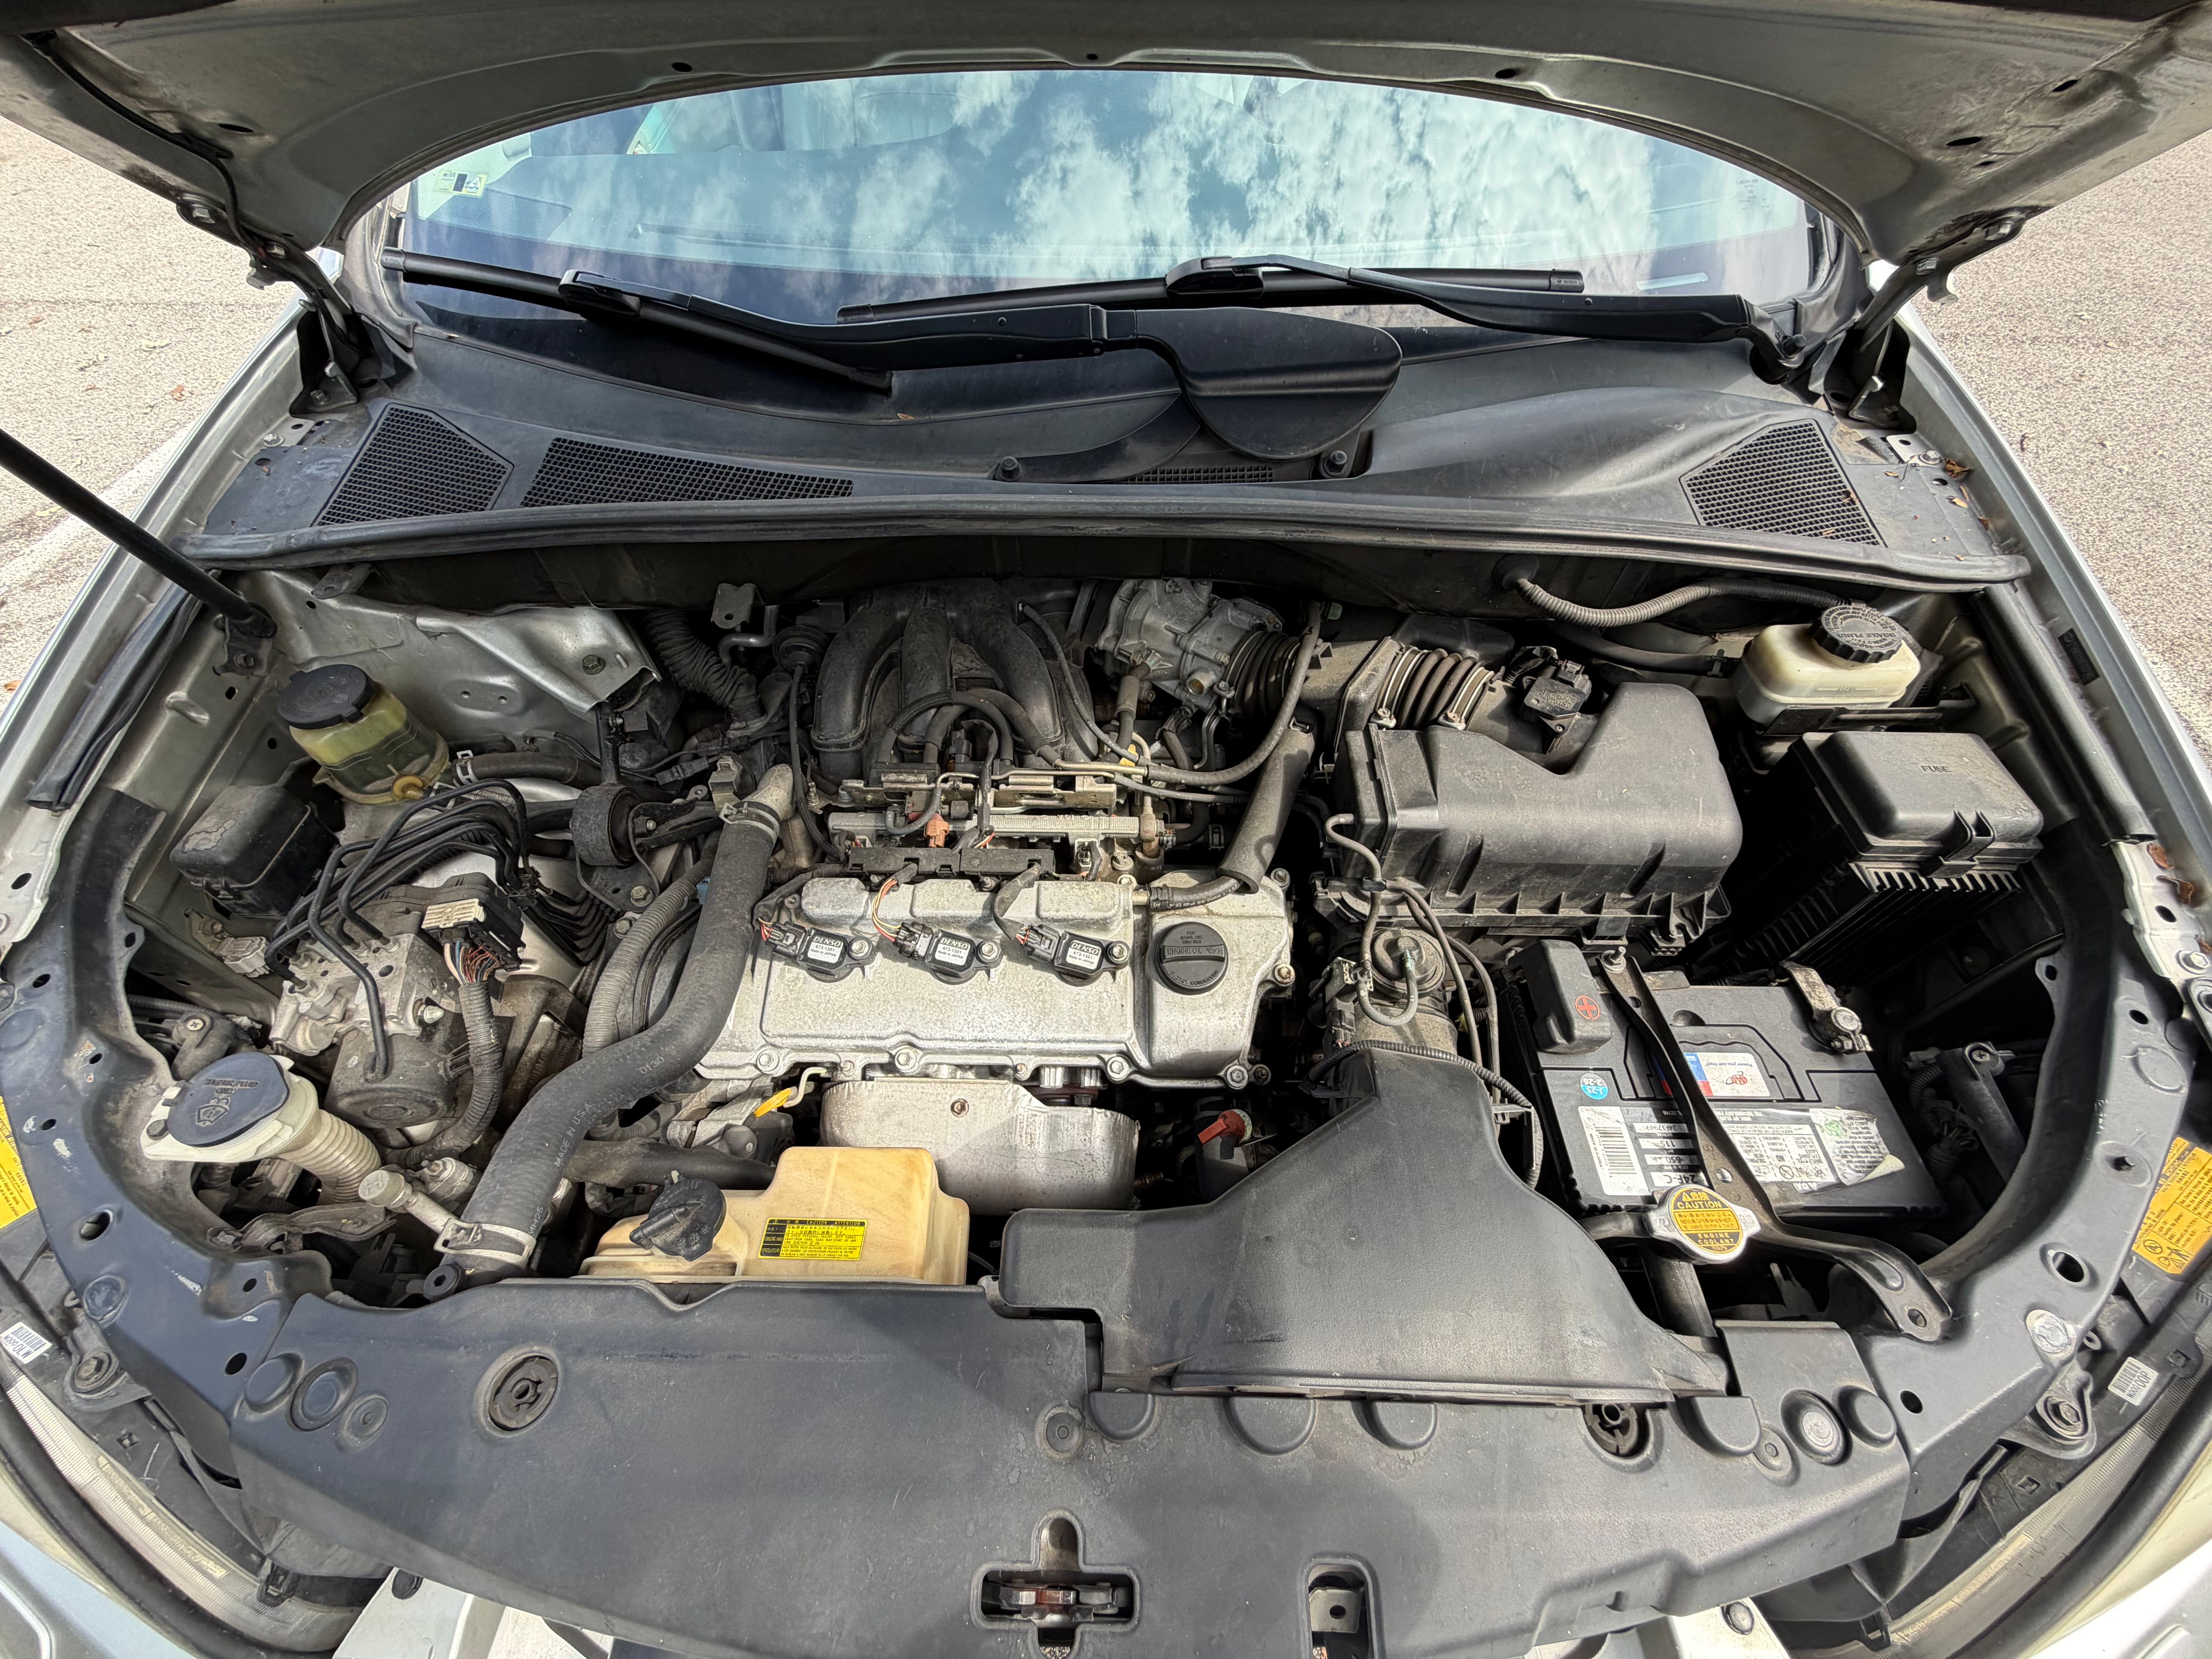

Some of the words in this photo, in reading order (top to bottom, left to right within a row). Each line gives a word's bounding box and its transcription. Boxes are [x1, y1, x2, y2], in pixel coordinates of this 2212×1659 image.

[813, 936, 841, 947] DENSO
[940, 938, 968, 949] DENSO
[1071, 942, 1099, 955] DENSO
[639, 1056, 665, 1073] 0130
[1583, 1078, 1602, 1086] 2-26
[553, 1139, 570, 1167] MADE
[566, 1127, 576, 1137] IN
[364, 1173, 383, 1195] H
[1664, 1174, 1698, 1184] 24F-C
[1677, 1201, 1722, 1209] CAUTION
